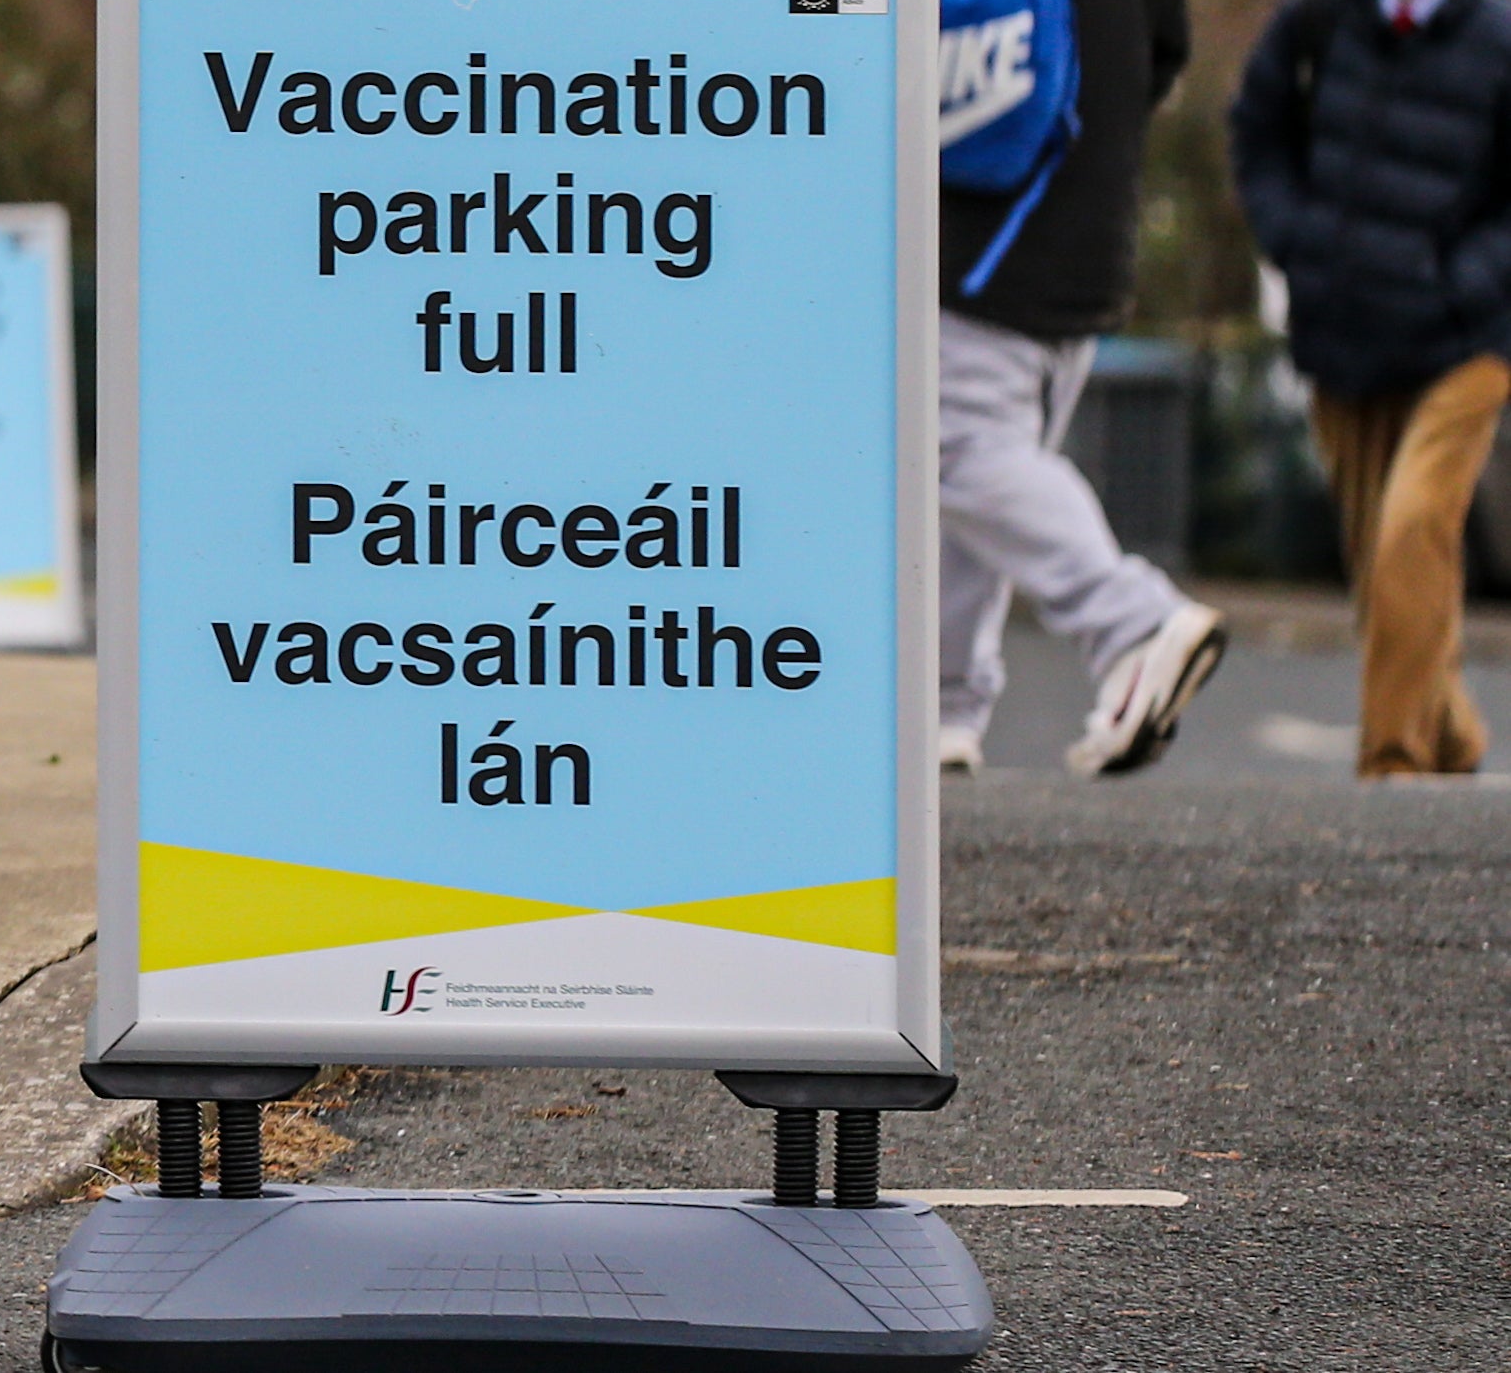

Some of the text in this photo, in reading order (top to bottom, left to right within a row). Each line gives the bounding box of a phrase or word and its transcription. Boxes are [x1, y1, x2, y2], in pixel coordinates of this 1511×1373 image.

[203, 52, 826, 137] Vaccination
[939, 10, 1035, 107] IKE
[318, 172, 712, 279] parking
[415, 290, 577, 374] full
[292, 480, 740, 569] Páirceáil
[210, 602, 822, 691] vacsaínithe
[441, 719, 591, 807] lán
[445, 997, 586, 1009] Health Service Executive
[543, 985, 557, 994] na
